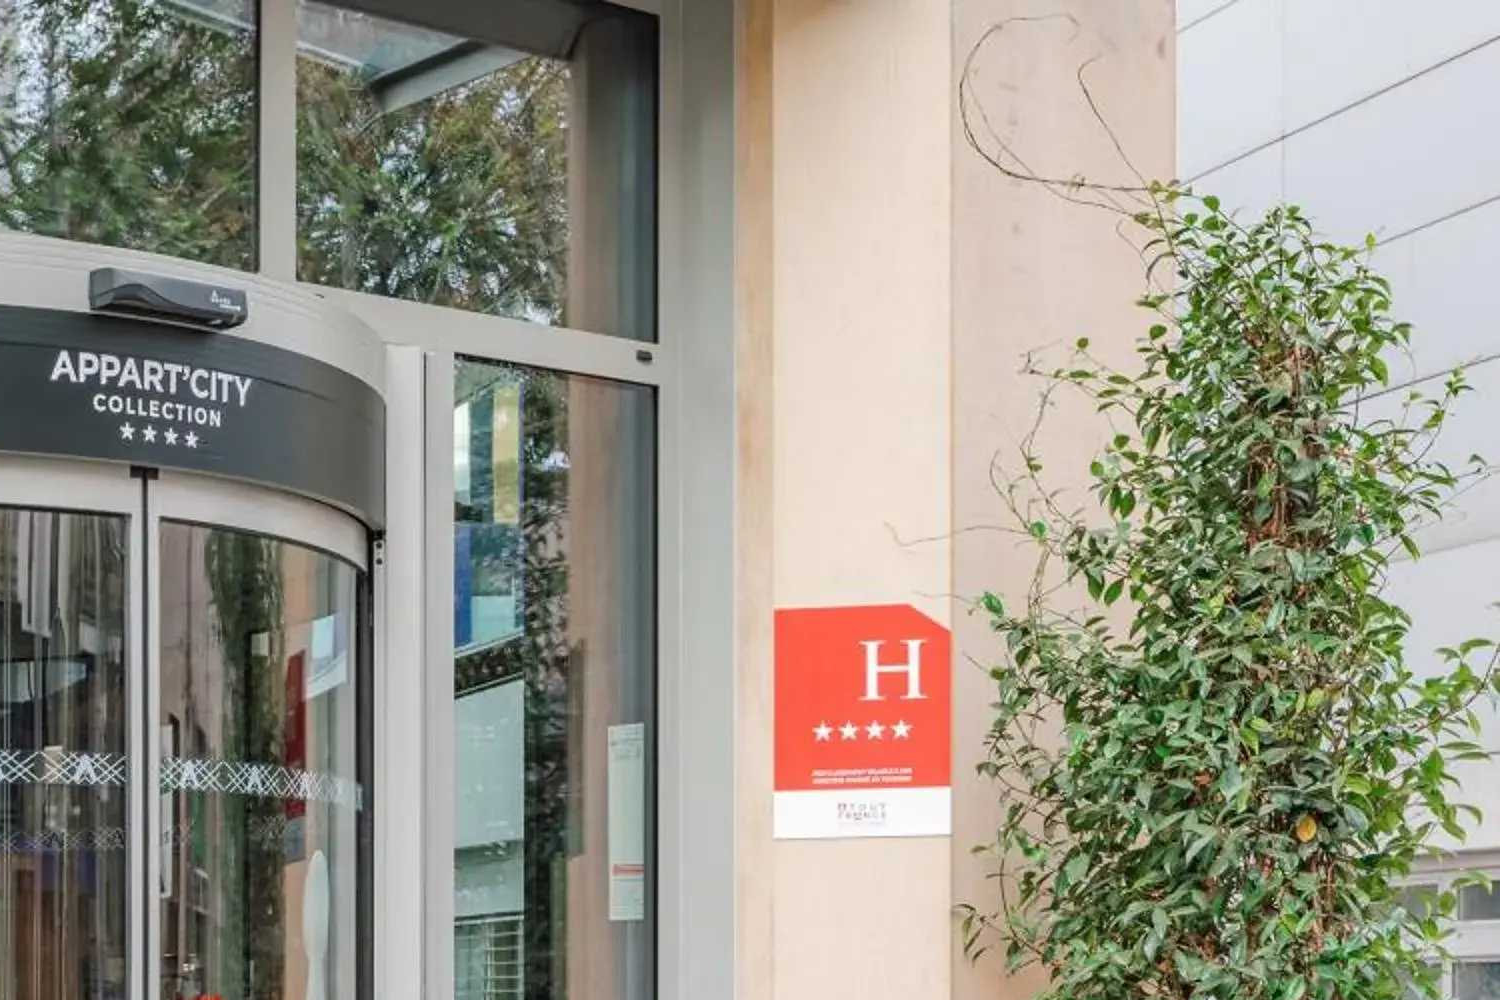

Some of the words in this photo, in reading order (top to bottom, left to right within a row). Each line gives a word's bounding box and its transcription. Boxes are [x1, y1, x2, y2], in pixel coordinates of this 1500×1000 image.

[50, 350, 252, 406] APPART'CITY
[93, 393, 221, 427] COLLECTION
[858, 638, 929, 701] H
